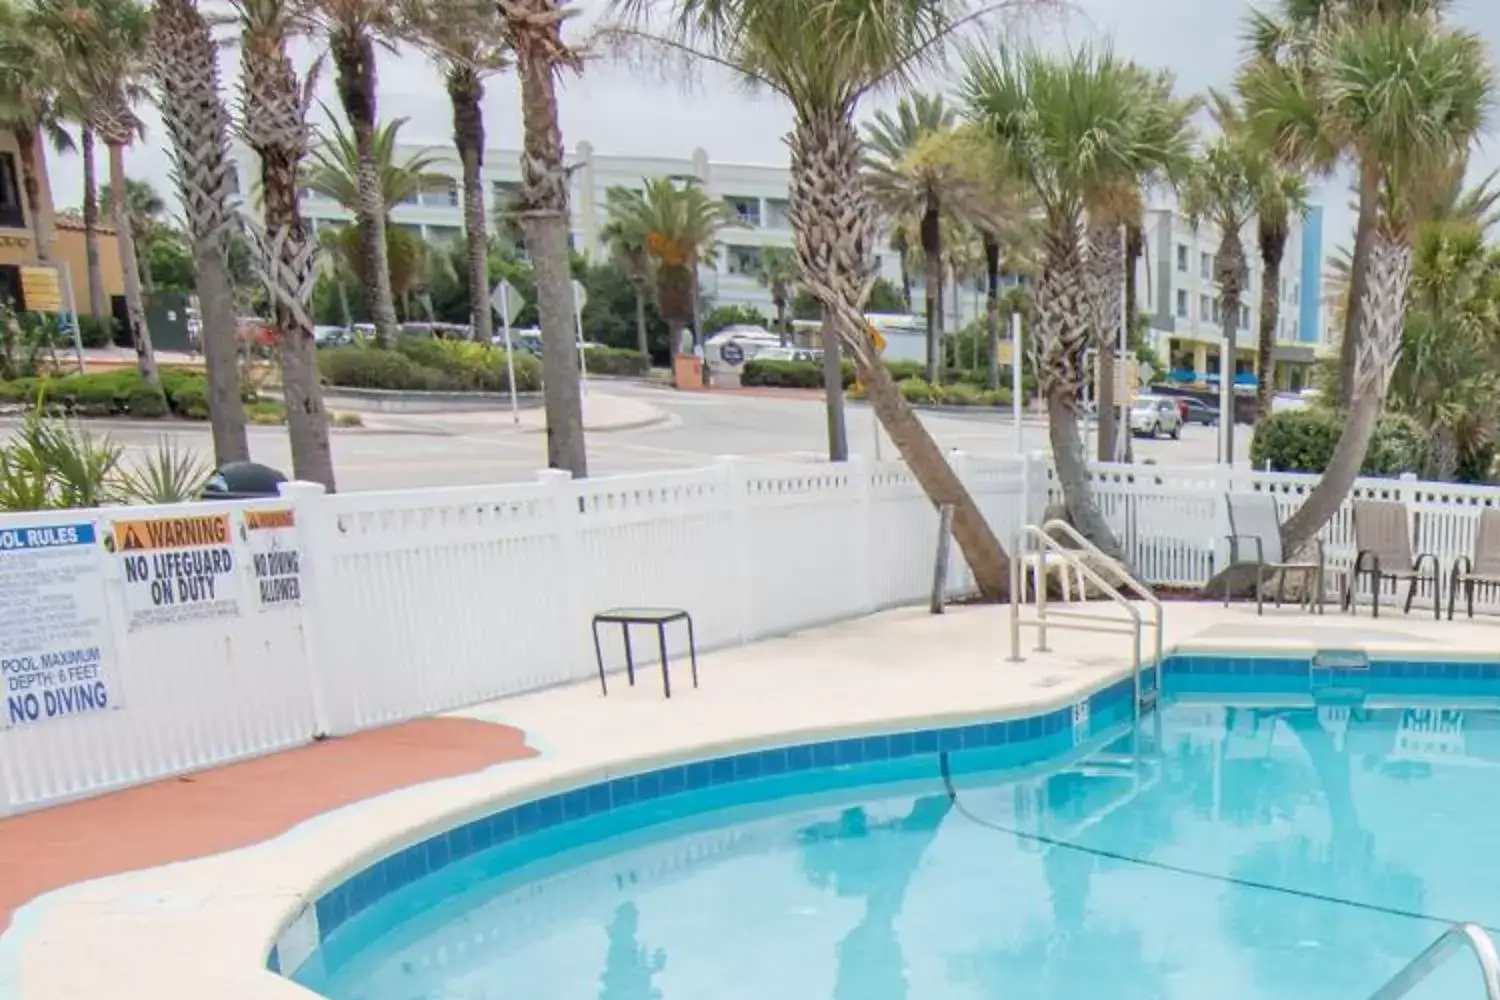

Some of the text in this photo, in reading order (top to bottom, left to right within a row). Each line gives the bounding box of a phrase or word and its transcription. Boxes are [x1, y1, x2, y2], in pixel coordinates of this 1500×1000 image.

[0, 527, 78, 549] OL RULES
[146, 517, 225, 548] WARNING
[124, 548, 232, 582] NO LIFEGUARD
[151, 575, 215, 605] ON DUTY
[2, 647, 100, 674] POOL MAXIMUM
[68, 664, 98, 681] FEET
[8, 681, 107, 724] NO DIVING
